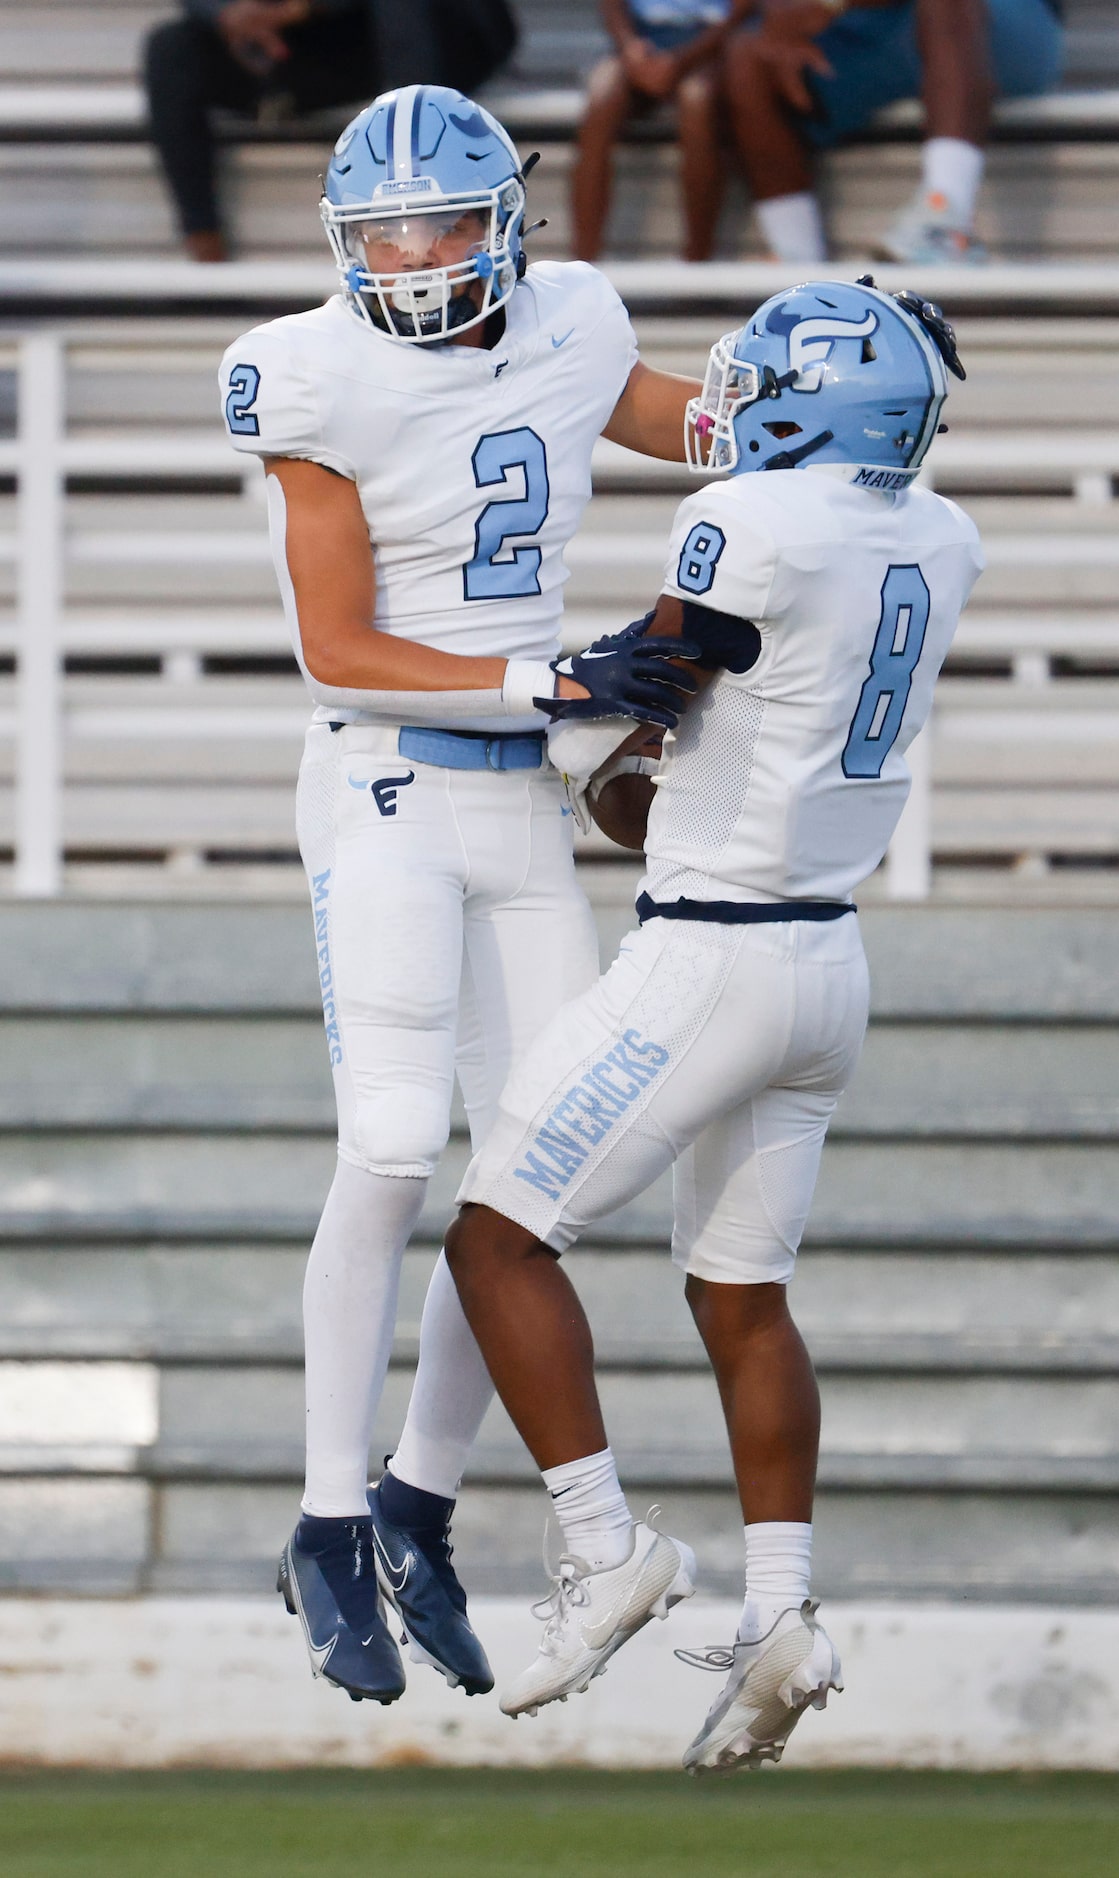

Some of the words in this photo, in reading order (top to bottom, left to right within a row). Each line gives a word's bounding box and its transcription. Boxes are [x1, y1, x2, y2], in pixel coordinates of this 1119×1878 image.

[225, 363, 262, 437] 2
[463, 425, 550, 602] 2
[677, 520, 727, 596] 8
[841, 563, 931, 779] 8
[513, 1028, 670, 1202] MAVERICKS
